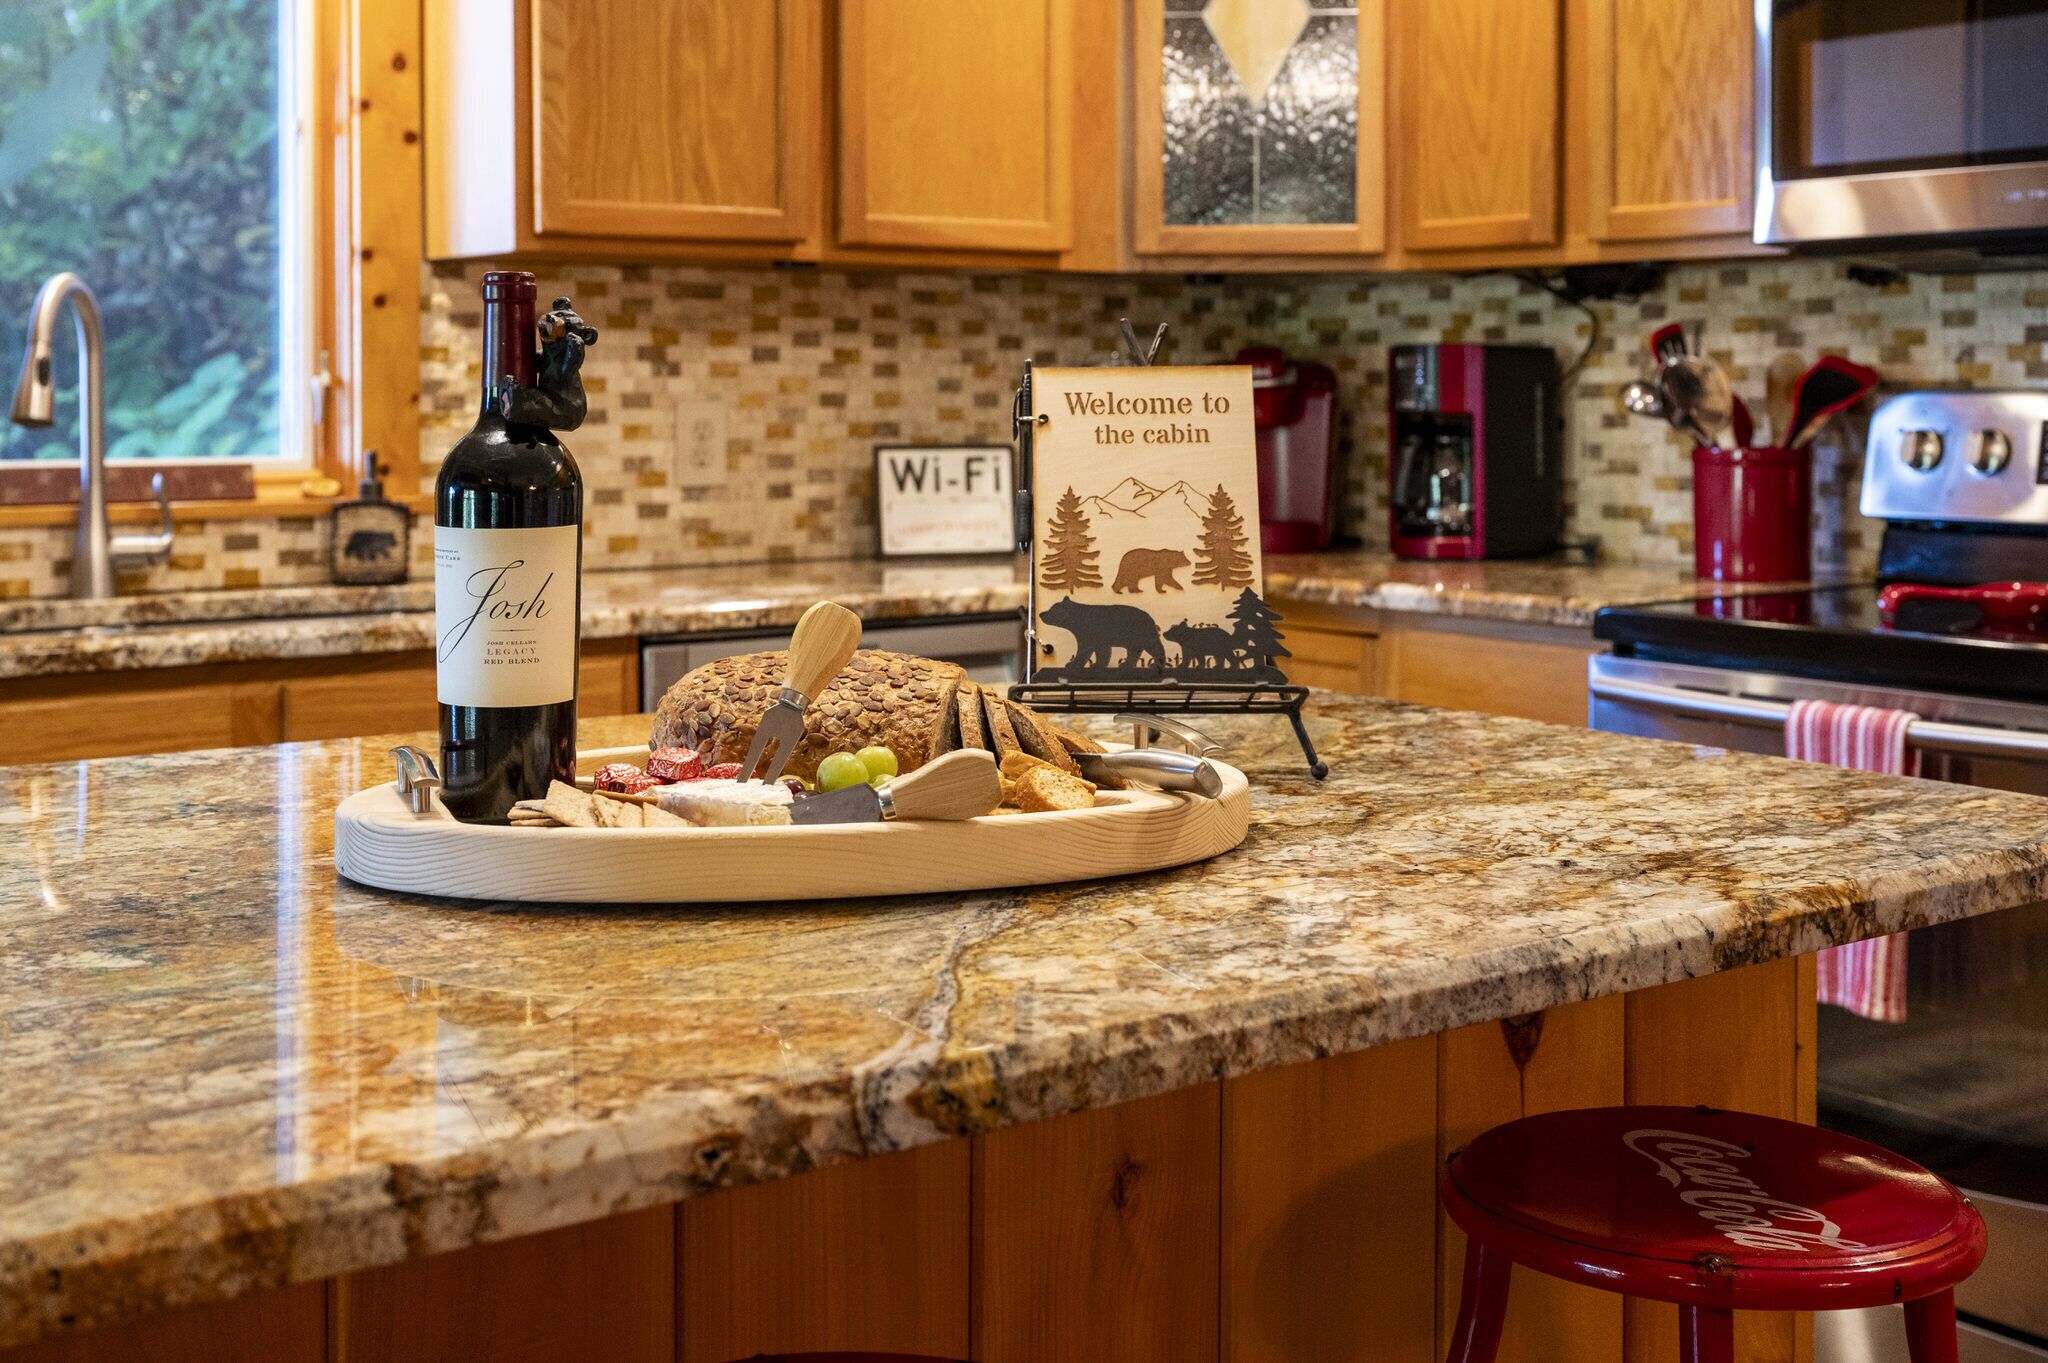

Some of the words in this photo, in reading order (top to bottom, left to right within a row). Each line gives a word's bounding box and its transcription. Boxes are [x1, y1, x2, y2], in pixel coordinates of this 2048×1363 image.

[1063, 391, 1193, 416] Welcome
[1202, 391, 1230, 414] to
[1094, 424, 1135, 445] the
[1143, 423, 1210, 444] cabin
[889, 456, 1001, 493] Wi-Fi
[438, 559, 554, 663] Josh
[487, 647, 536, 656] LEGACY
[508, 657, 540, 665] BLEND
[1622, 1128, 1868, 1252] Coca-Cola
